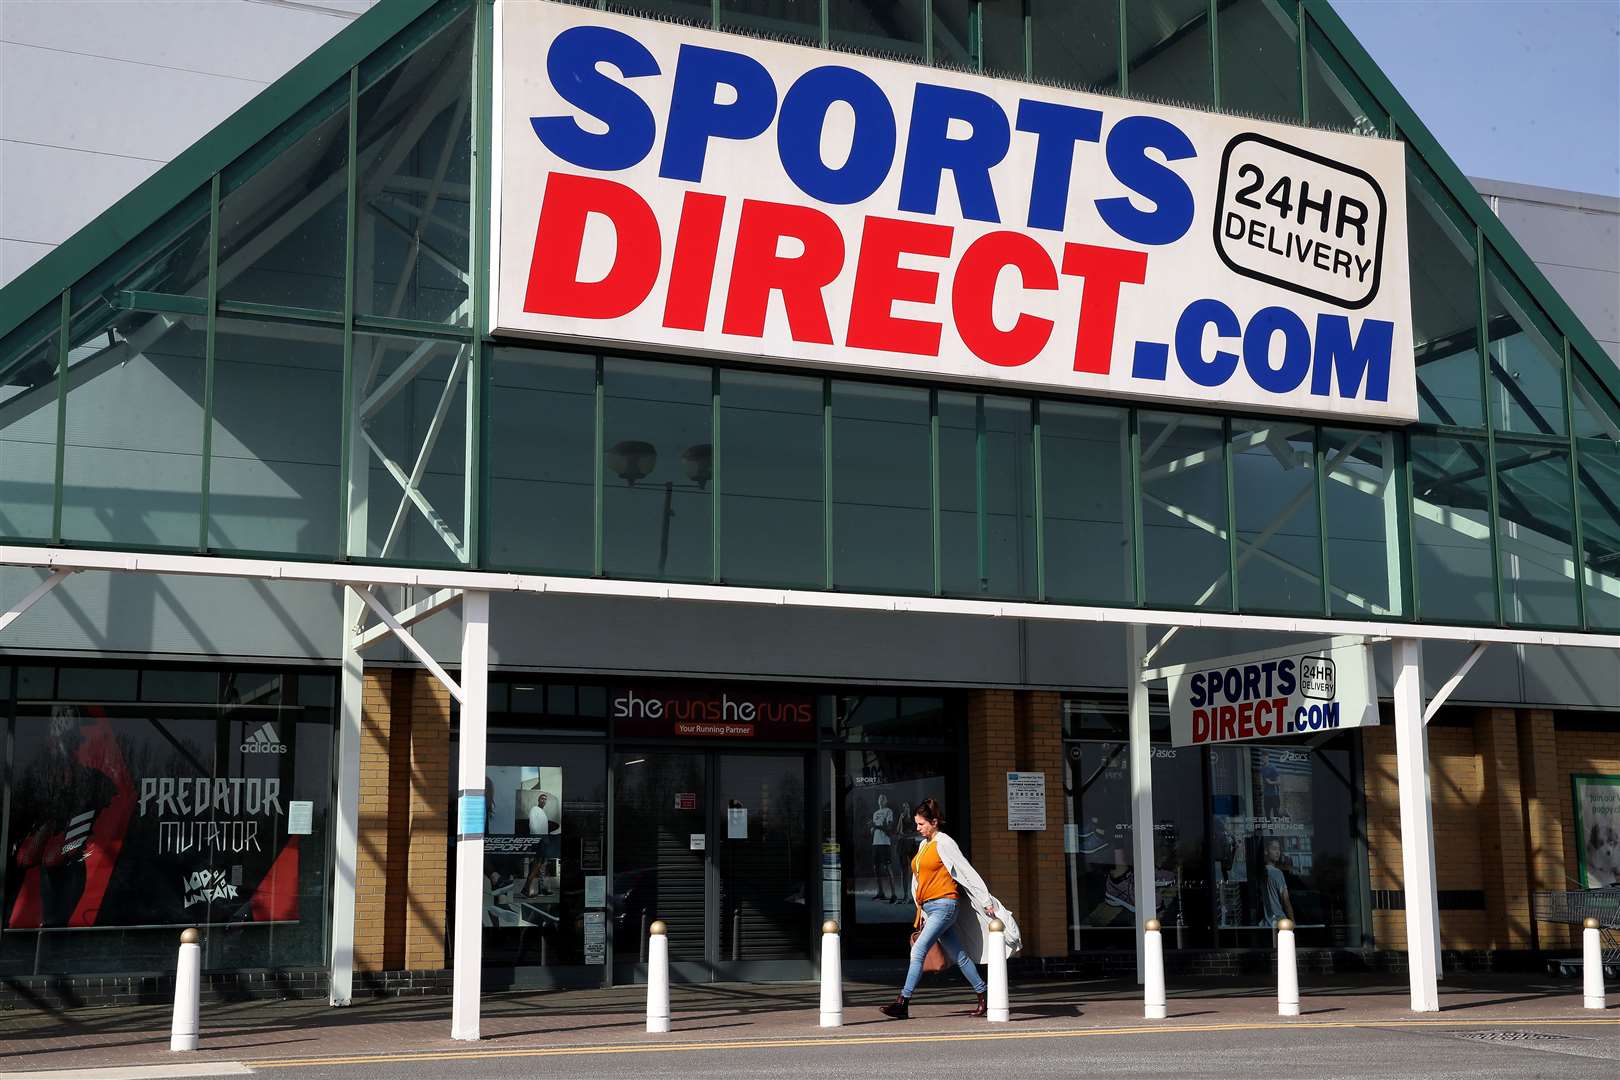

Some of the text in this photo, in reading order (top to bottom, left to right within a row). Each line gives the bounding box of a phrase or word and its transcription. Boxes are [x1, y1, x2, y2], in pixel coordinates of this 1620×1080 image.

[529, 25, 1197, 246] SPORTS
[1235, 163, 1369, 246] 24HR
[1225, 211, 1372, 283] DELIVERY
[523, 171, 1395, 402] DIRECT.COM
[1189, 658, 1297, 708] SPORTS
[1302, 680, 1334, 693] DELIVERY
[1303, 664, 1333, 682] 24HR
[679, 724, 750, 735] Your Running Partner
[1192, 697, 1340, 744] DIRECT.COM
[239, 742, 288, 754] adidas
[1156, 749, 1177, 758] asics
[138, 777, 284, 817] PREDATOR
[159, 821, 261, 855] MUTATOR
[484, 843, 532, 851] SPORT
[183, 869, 226, 893] 100%
[183, 882, 240, 909] UNFAIR
